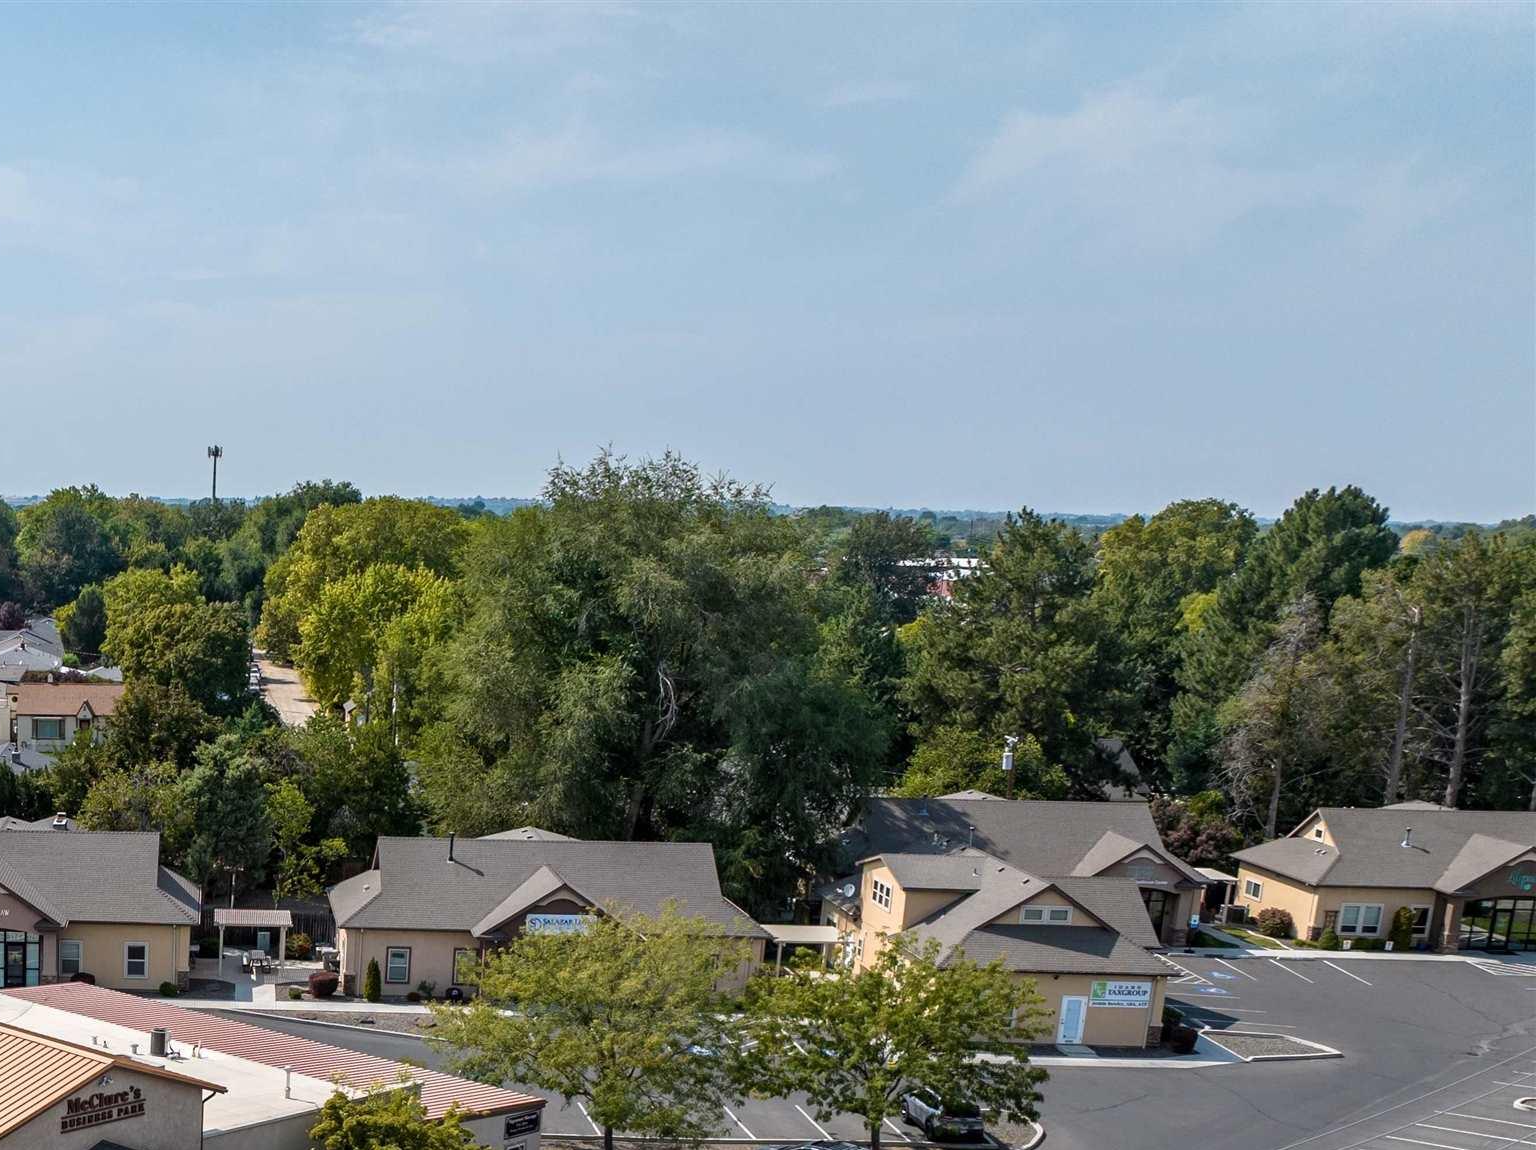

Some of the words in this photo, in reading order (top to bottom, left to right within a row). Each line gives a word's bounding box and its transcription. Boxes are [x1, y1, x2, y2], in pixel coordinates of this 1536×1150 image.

[67, 1085, 142, 1115] McClure's
[61, 1110, 114, 1130] BUSINESS
[117, 1102, 146, 1117] PARK
